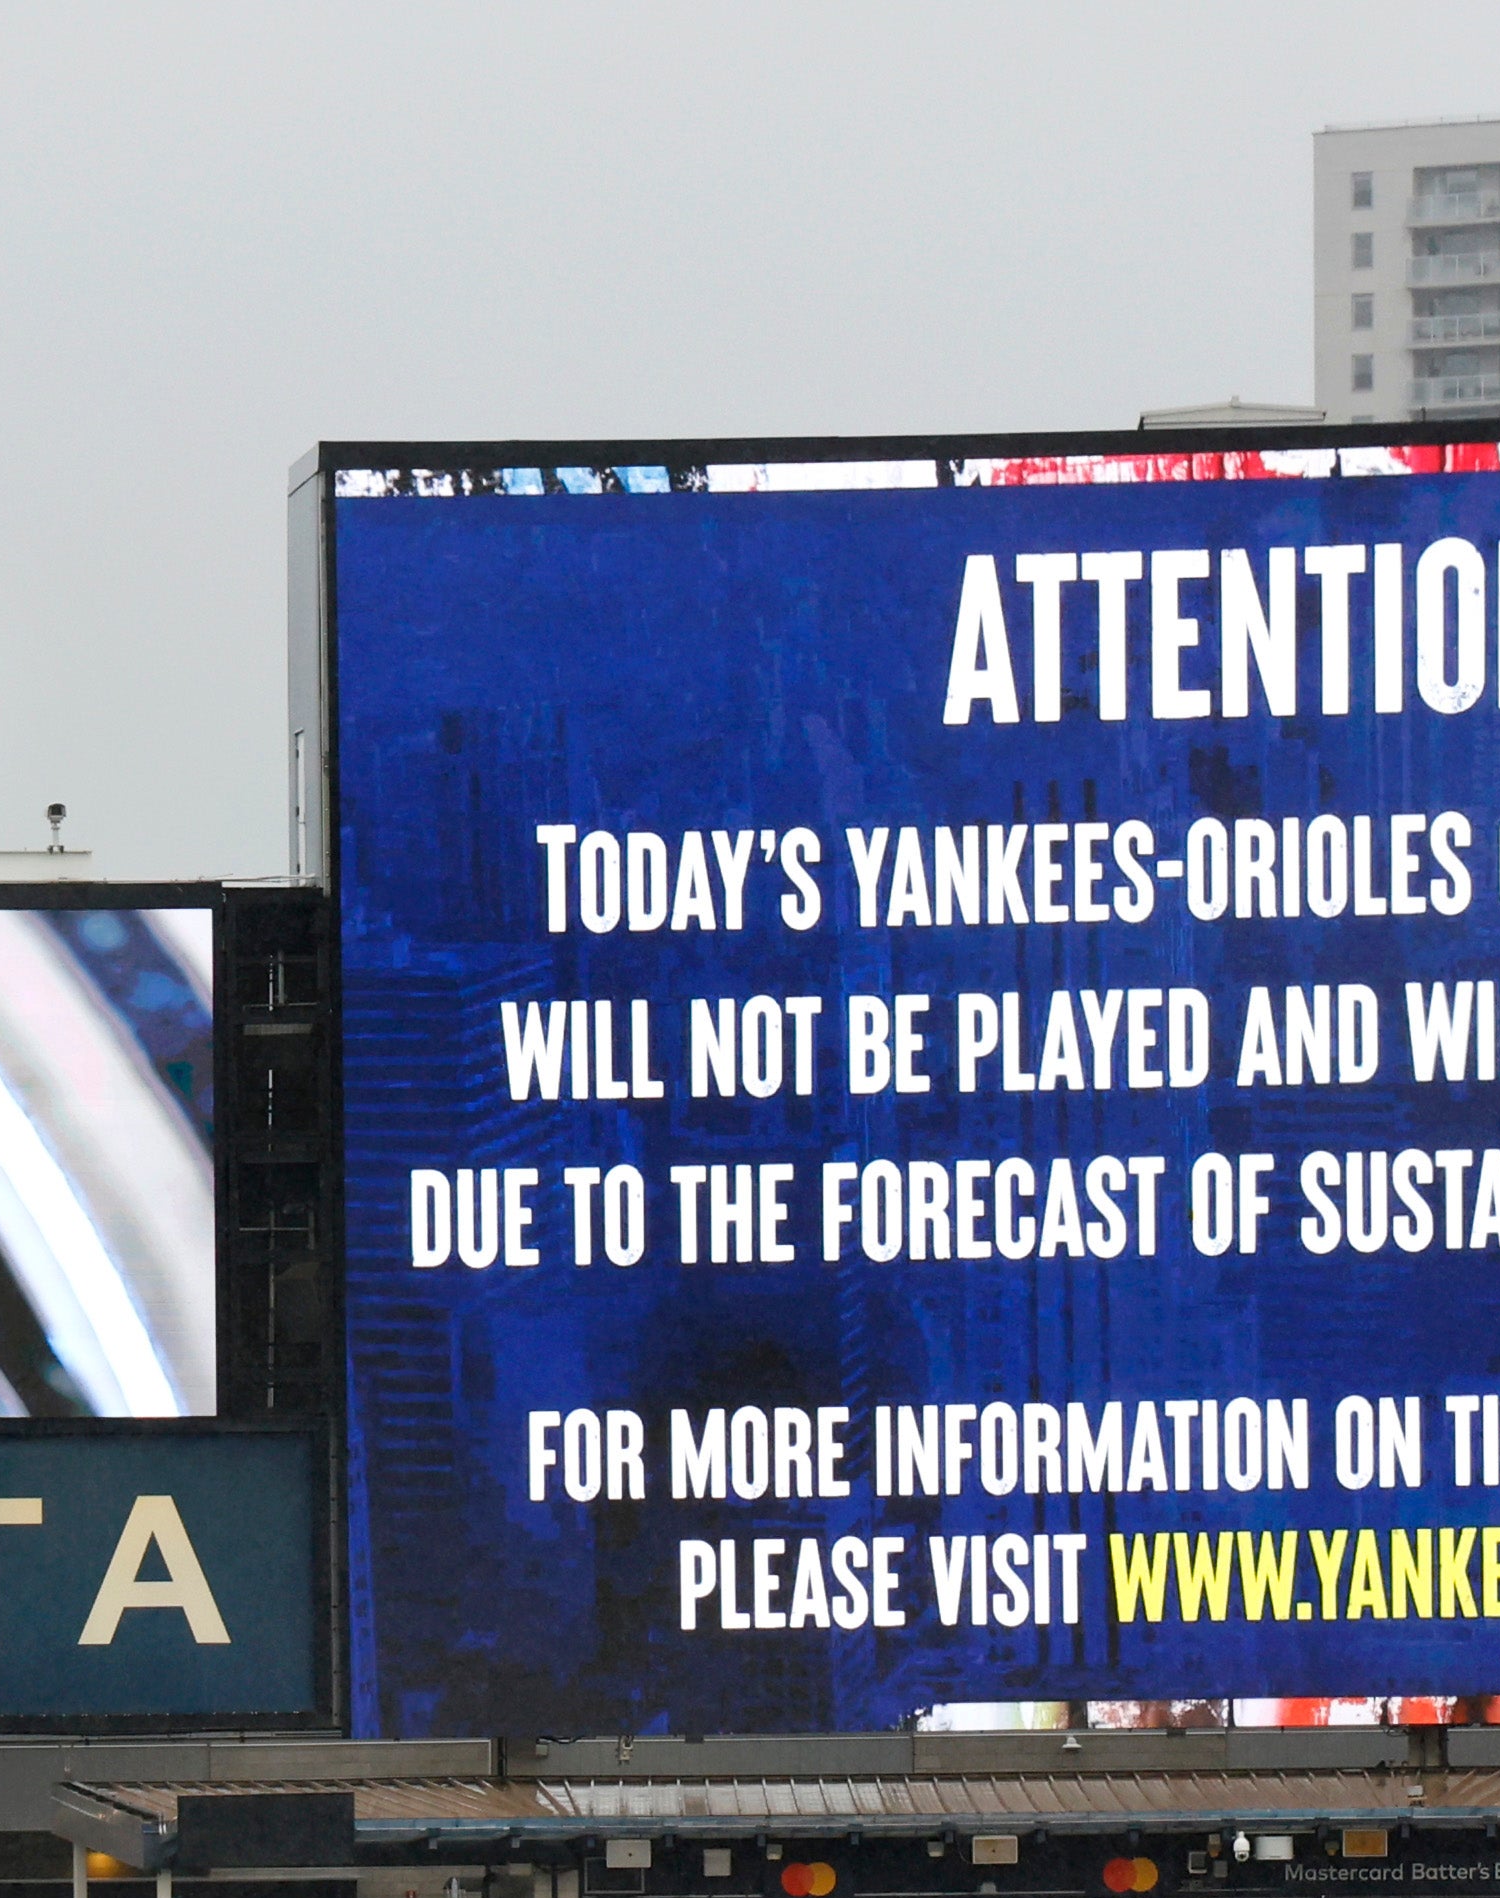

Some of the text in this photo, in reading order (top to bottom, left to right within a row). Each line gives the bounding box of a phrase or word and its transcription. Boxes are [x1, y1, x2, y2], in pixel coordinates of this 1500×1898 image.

[536, 822, 822, 935] TODAY'S
[846, 810, 1472, 929] YANKEES-ORIOLES
[499, 998, 665, 1102] WILL
[690, 995, 822, 1099] NOT
[848, 992, 932, 1096] BE
[957, 985, 1211, 1095] PLAYED
[1236, 983, 1380, 1088] AND
[410, 1166, 541, 1271] DUE
[563, 1163, 647, 1268] TO
[670, 1160, 796, 1265] THE
[821, 1153, 1166, 1264] FORECAST
[1190, 1151, 1271, 1258] OF
[527, 1408, 646, 1505] FOR
[670, 1404, 851, 1501] MORE
[874, 1397, 1310, 1498] INFORMATION
[1334, 1395, 1422, 1491] ON
[678, 1535, 906, 1633] PLEASE
[929, 1531, 1087, 1628] VISIT
[1285, 1863, 1404, 1881] Mastercard
[1412, 1862, 1490, 1881] Batter's
